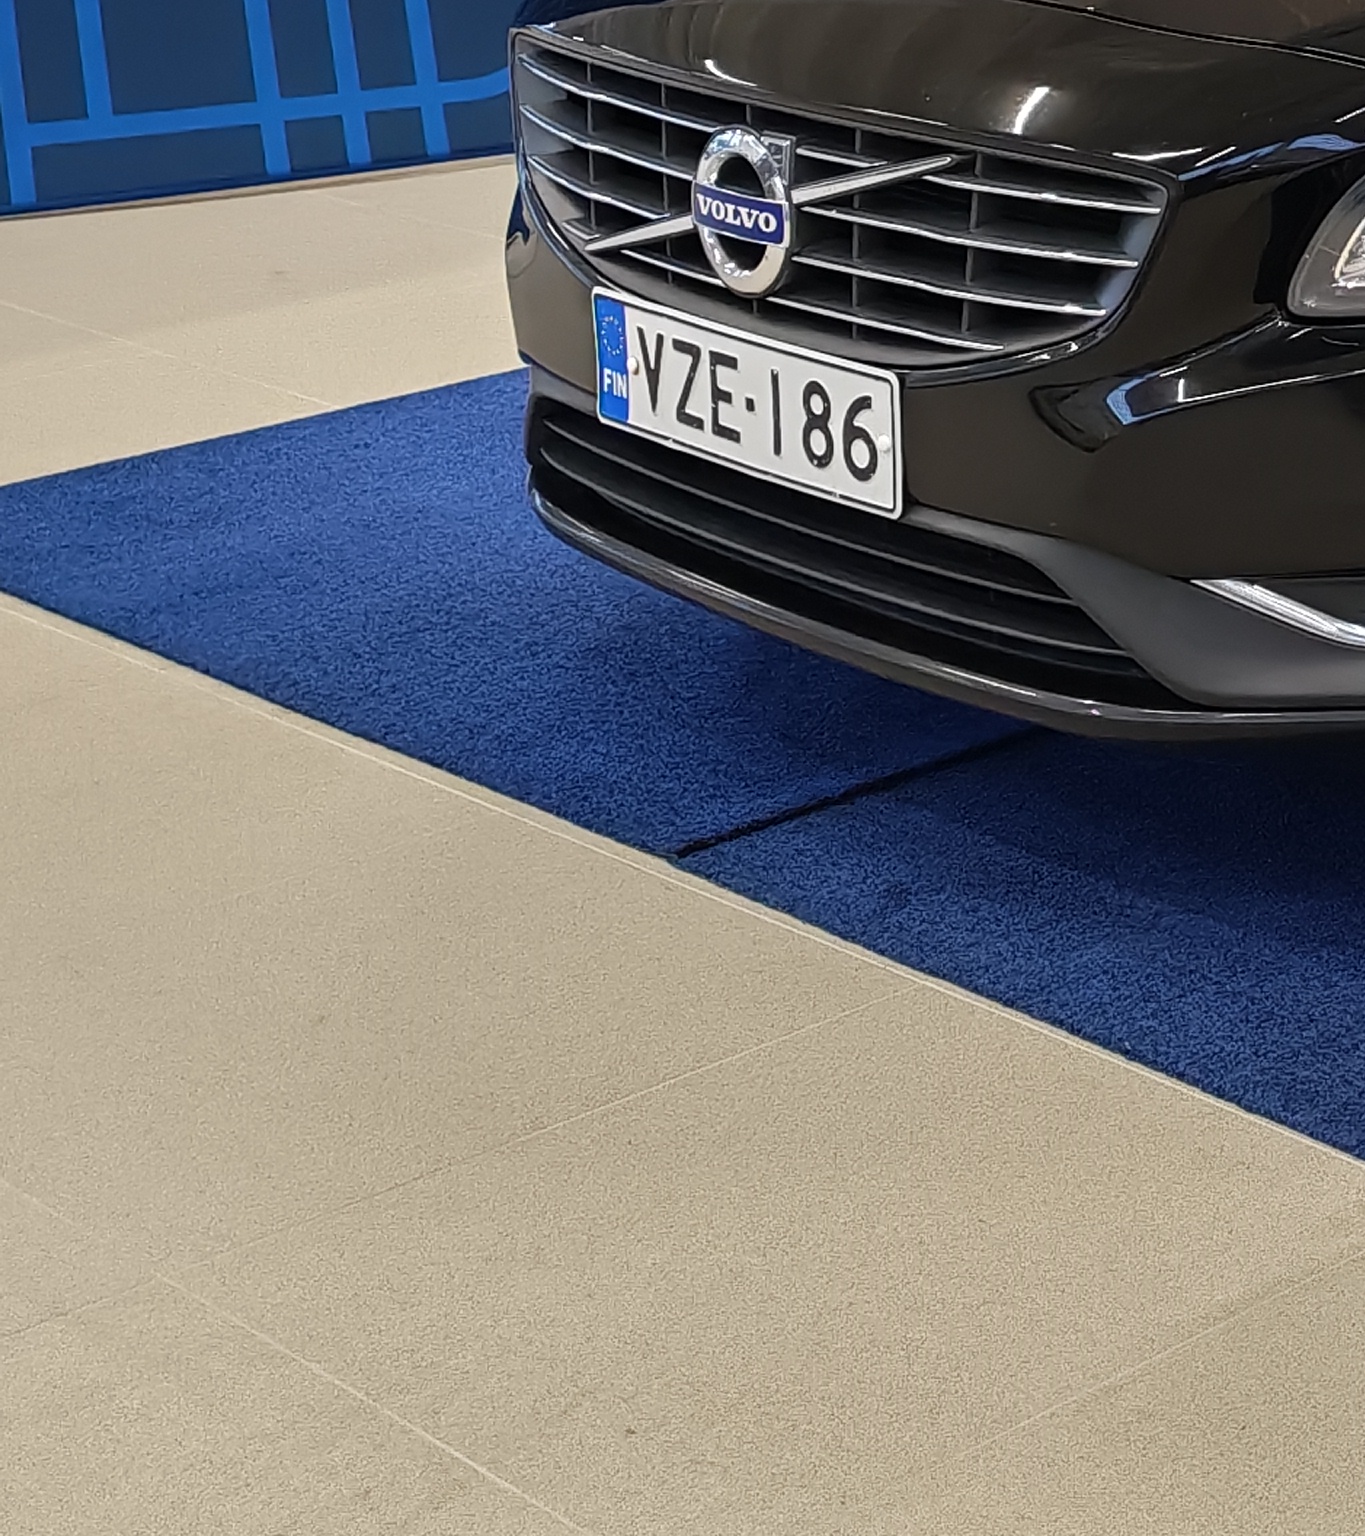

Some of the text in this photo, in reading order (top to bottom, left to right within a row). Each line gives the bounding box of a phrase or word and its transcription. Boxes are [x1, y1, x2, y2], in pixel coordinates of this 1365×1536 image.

[696, 193, 777, 233] VOLVO
[603, 367, 628, 399] FIN
[636, 326, 879, 482] VZE-186
